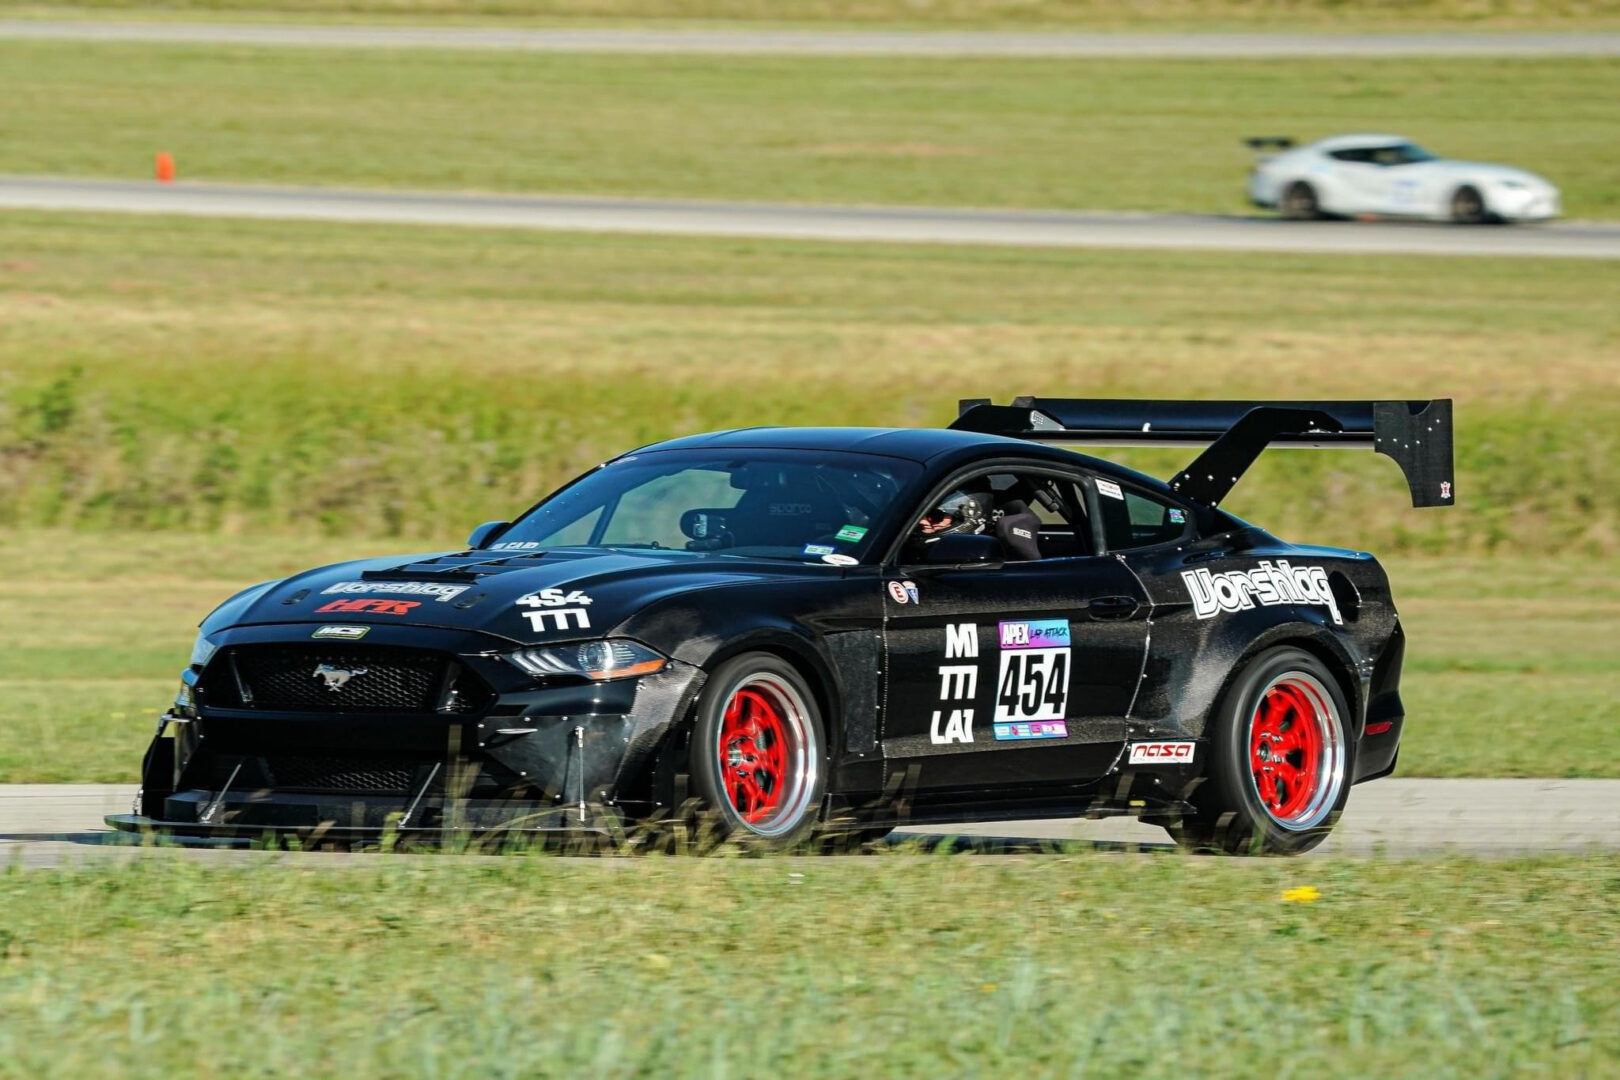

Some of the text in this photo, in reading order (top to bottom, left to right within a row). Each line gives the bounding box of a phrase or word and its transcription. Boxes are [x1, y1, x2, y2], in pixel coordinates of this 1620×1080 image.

[515, 588, 594, 608] 454
[1002, 623, 1030, 646] APEX
[998, 653, 1067, 716] 454
